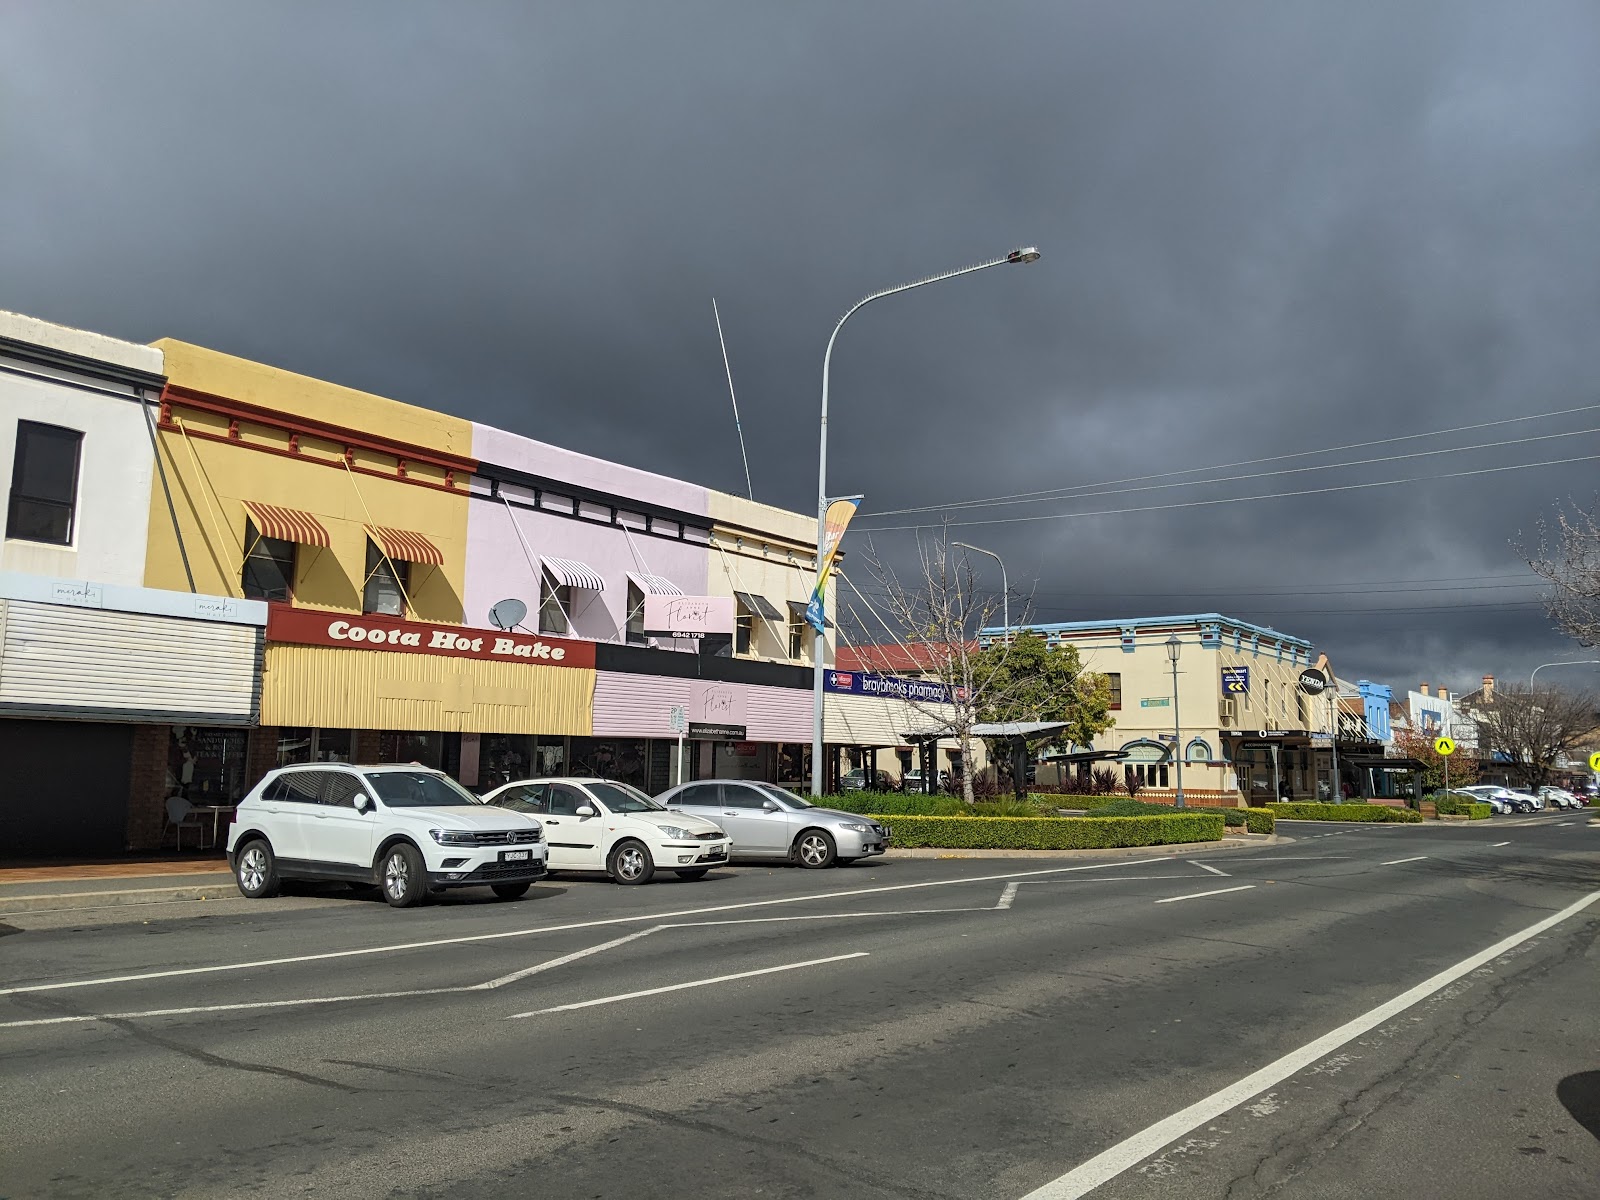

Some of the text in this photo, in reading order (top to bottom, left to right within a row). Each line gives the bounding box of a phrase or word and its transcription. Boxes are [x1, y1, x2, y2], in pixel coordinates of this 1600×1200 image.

[198, 598, 233, 613] meraki
[663, 597, 716, 629] Florist
[327, 620, 566, 660] Coota Hot Bake
[672, 631, 690, 639] 6942
[862, 674, 908, 695] braybrooks
[908, 683, 947, 702] pharmacy
[1301, 674, 1324, 689] YENDA
[702, 685, 737, 719] Florist
